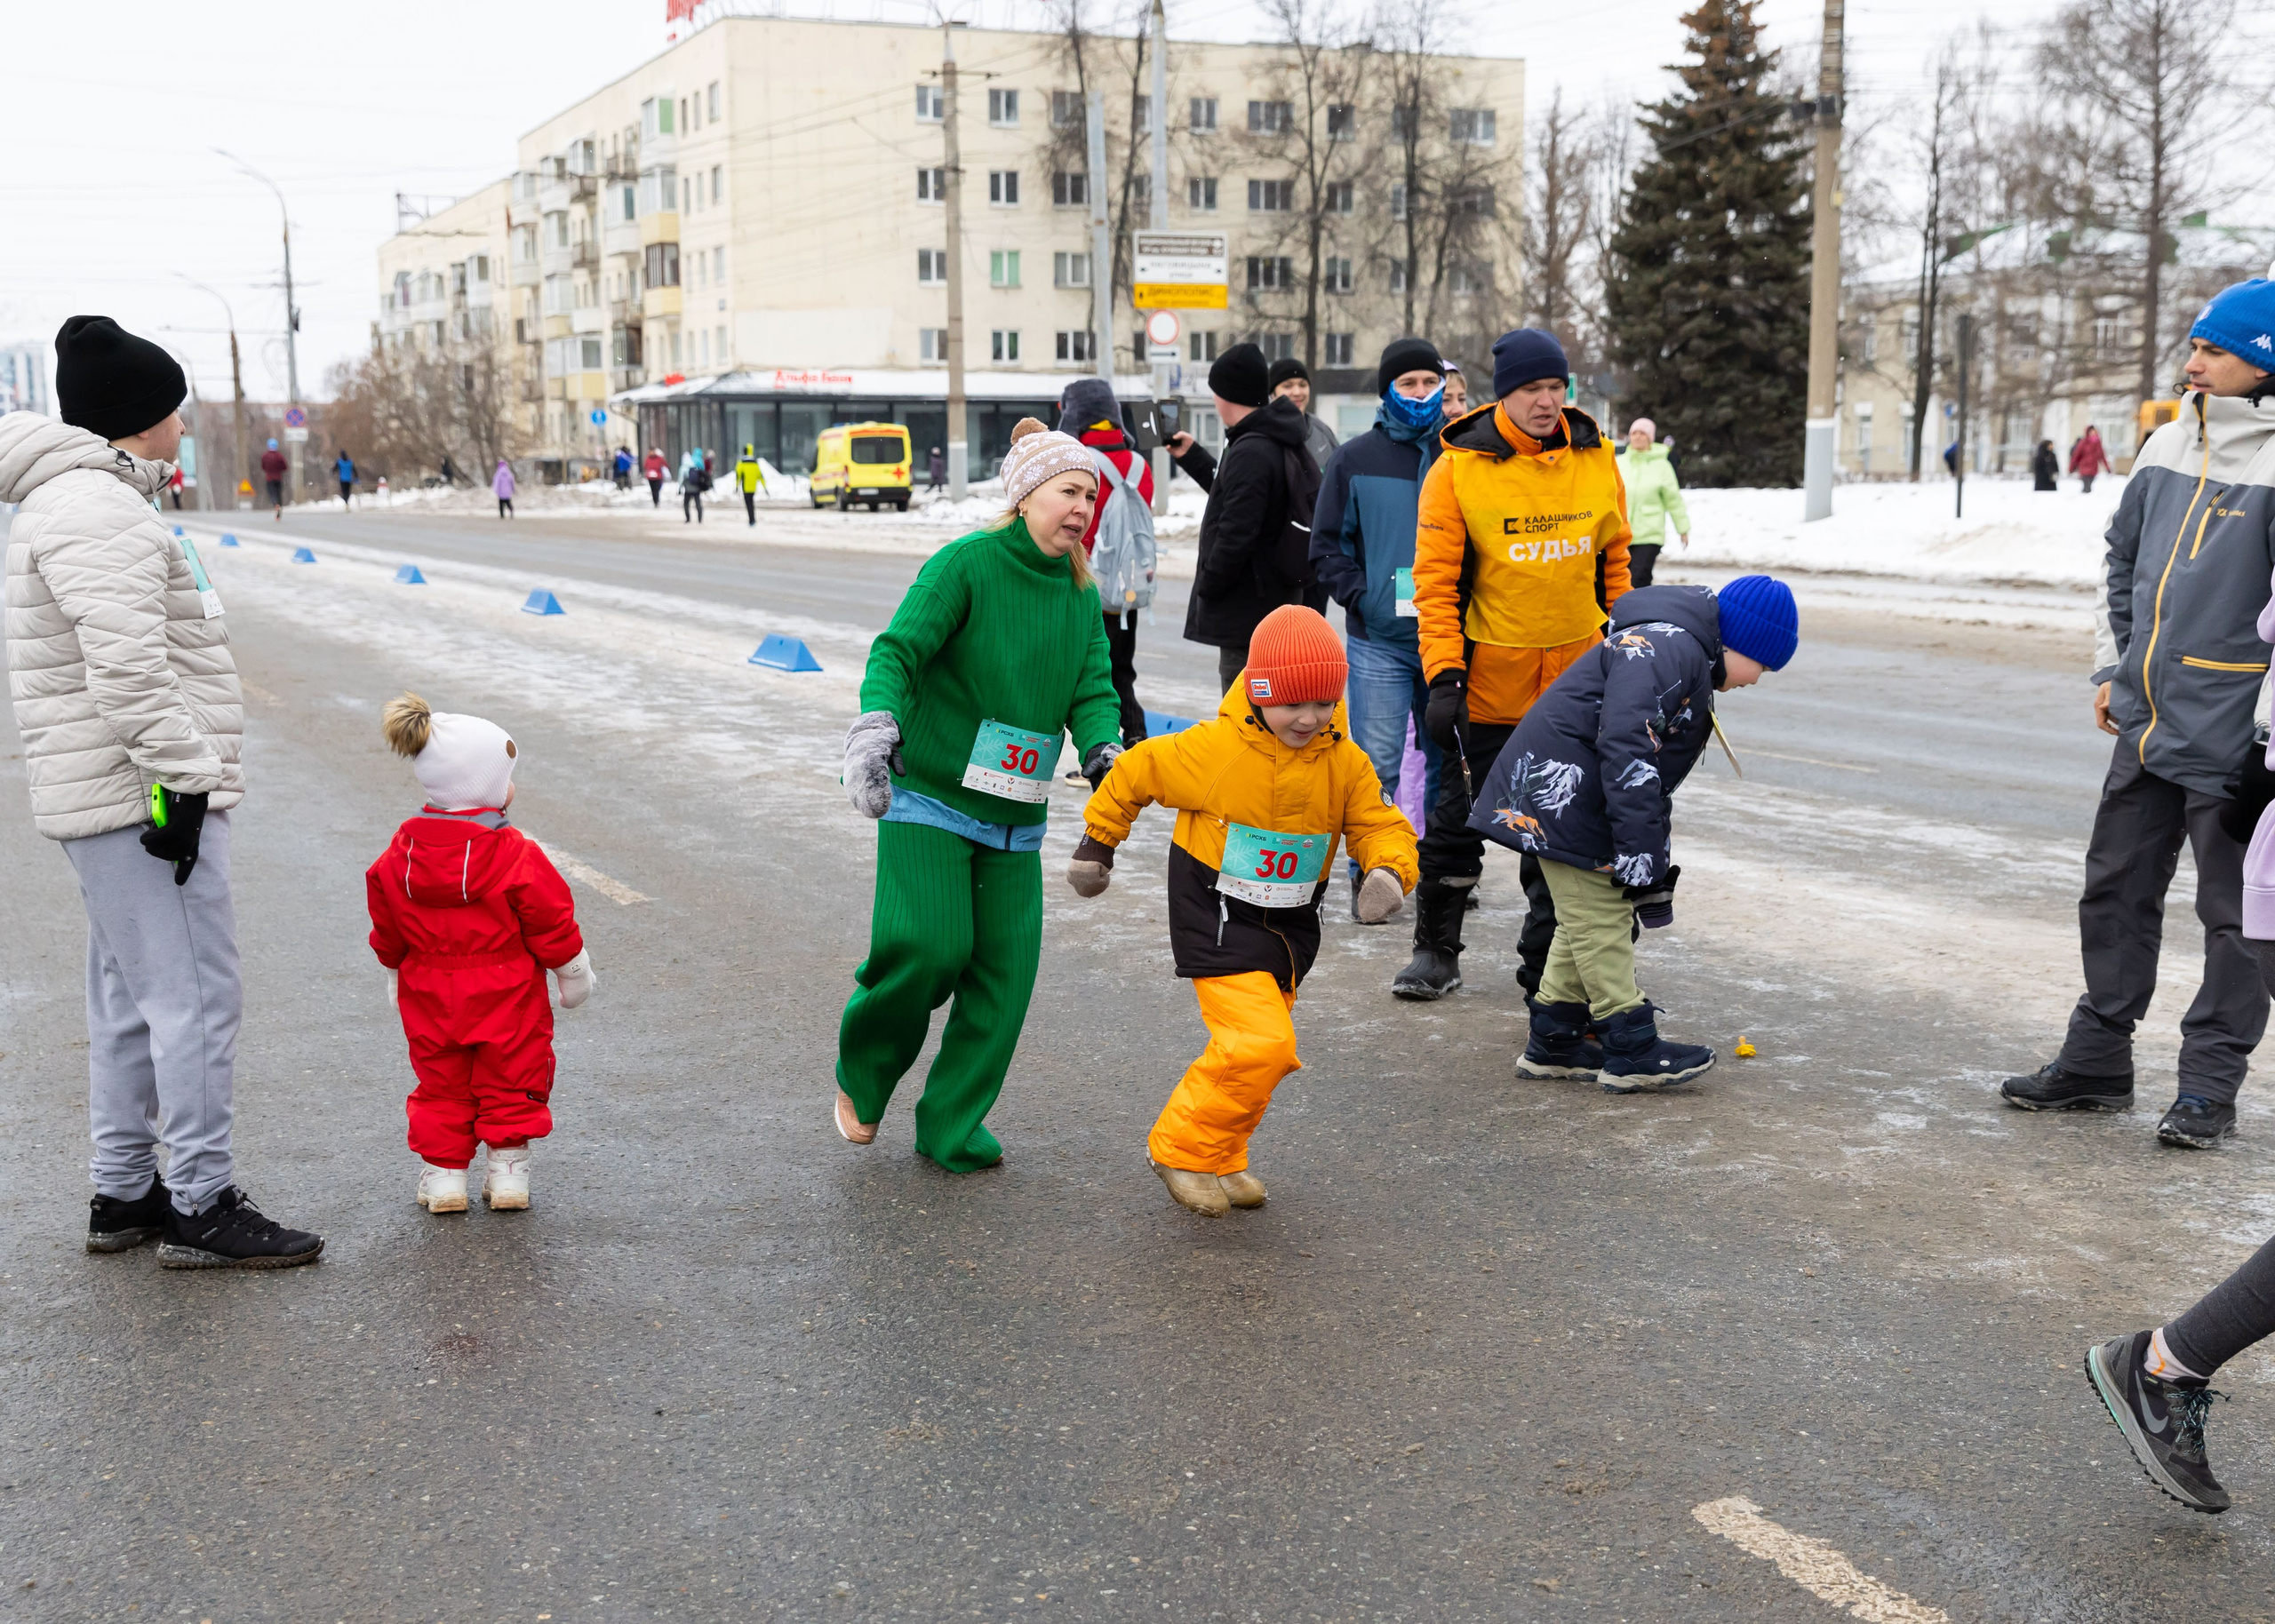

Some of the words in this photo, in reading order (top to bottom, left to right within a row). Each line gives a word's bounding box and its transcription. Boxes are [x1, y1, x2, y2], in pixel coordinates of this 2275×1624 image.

[1524, 510, 1592, 525] КАЛАШНИКОВ
[1525, 522, 1560, 533] СПОРТ
[1508, 536, 1592, 563] СУДЬЯ
[1001, 743, 1040, 775] 30
[1255, 848, 1298, 880] 30
